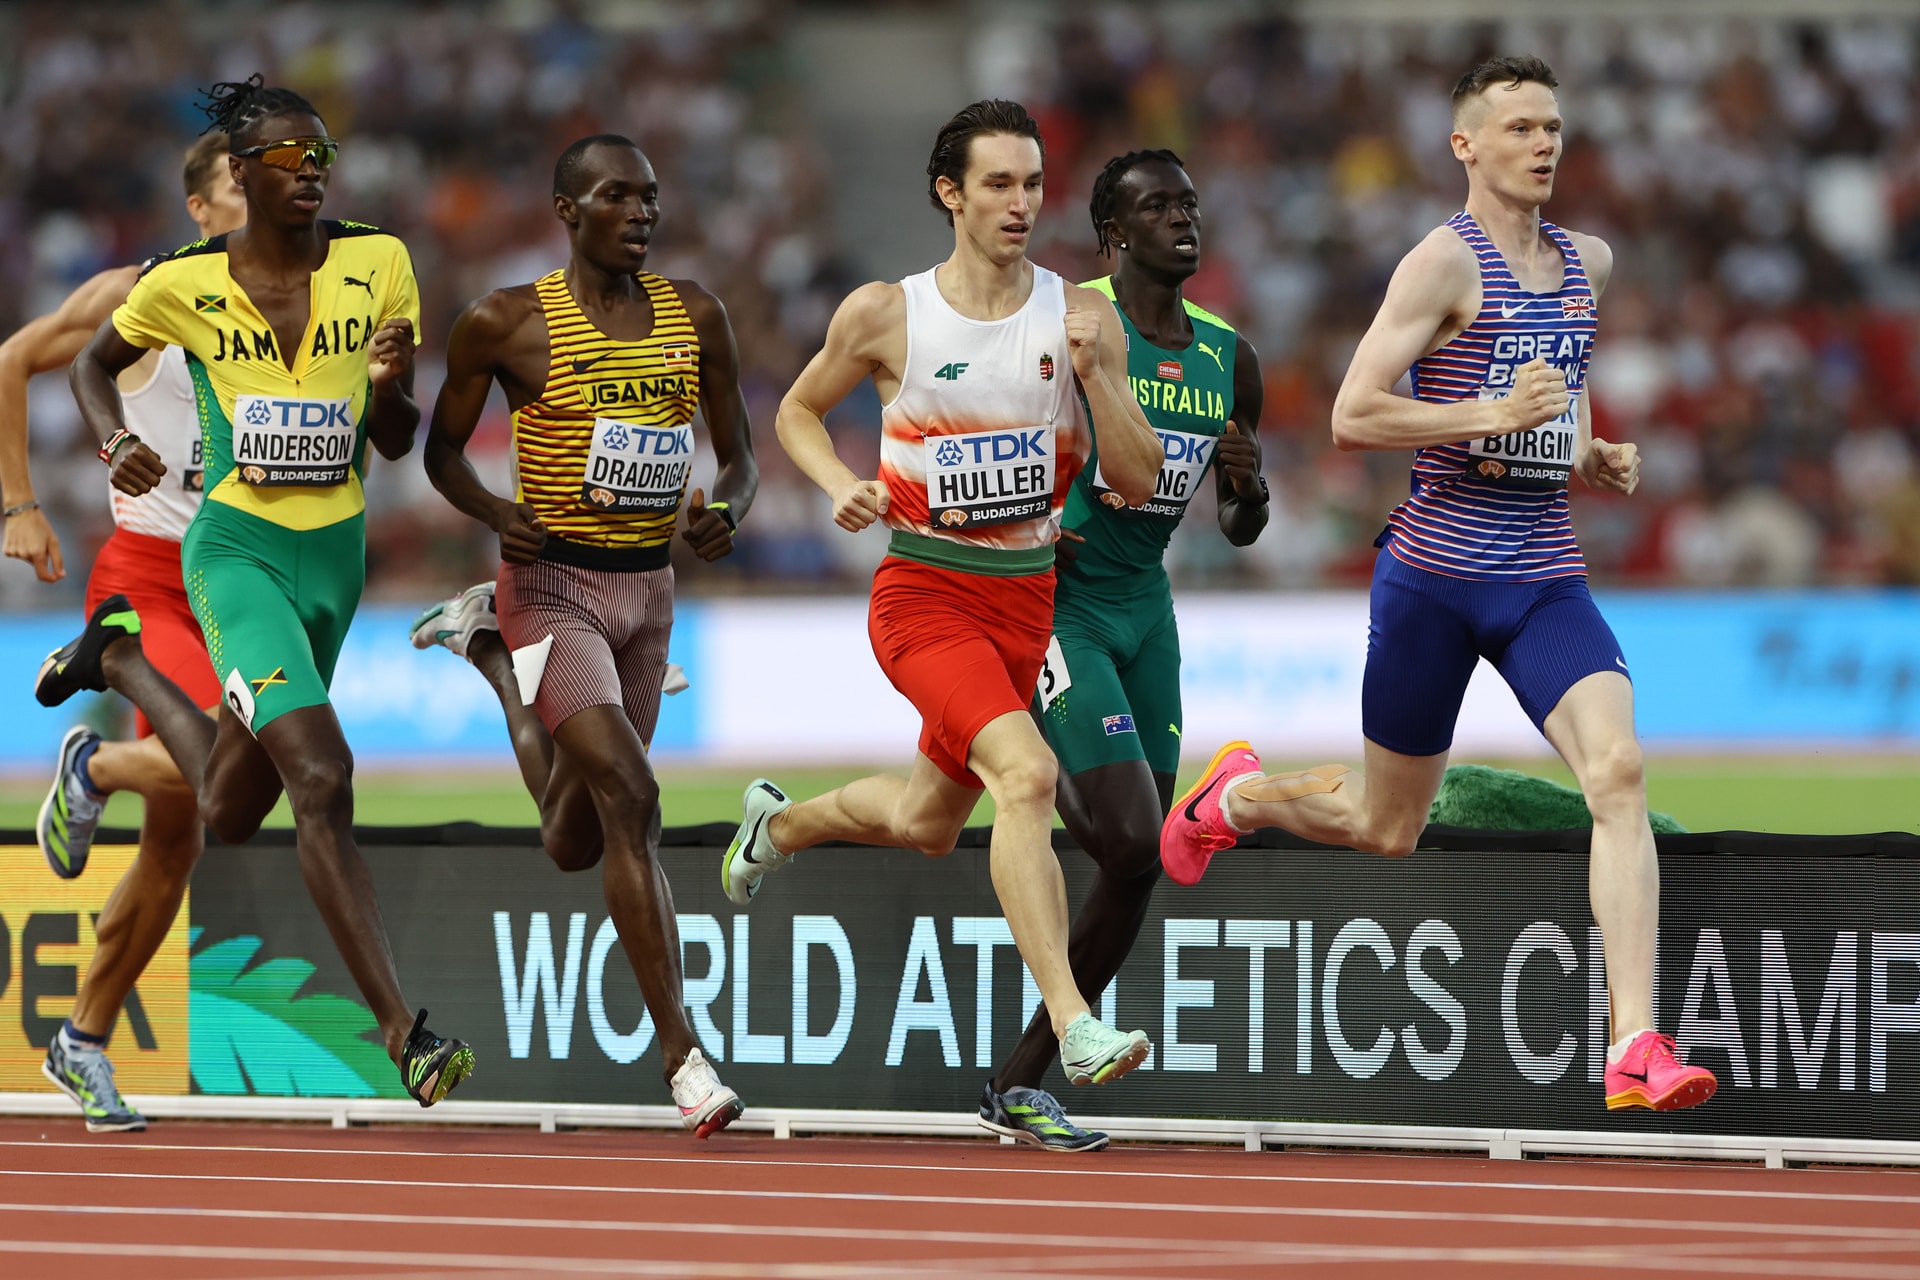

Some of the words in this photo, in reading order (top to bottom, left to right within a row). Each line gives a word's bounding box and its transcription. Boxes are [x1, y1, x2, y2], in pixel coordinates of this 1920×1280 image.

[1493, 334, 1590, 359] GREAT
[581, 376, 688, 407] UGANDA
[1127, 375, 1225, 421] USTRALIA
[272, 400, 351, 428] TDK
[238, 432, 351, 462] ANDERSON
[631, 427, 690, 456] TDK
[961, 429, 1048, 464] TDK
[1482, 429, 1573, 461] BURGIN
[591, 456, 687, 490] DRADRIGA
[939, 464, 1046, 503] HULLER
[493, 911, 857, 1065] WORLD
[884, 916, 1468, 1081] ATETICS
